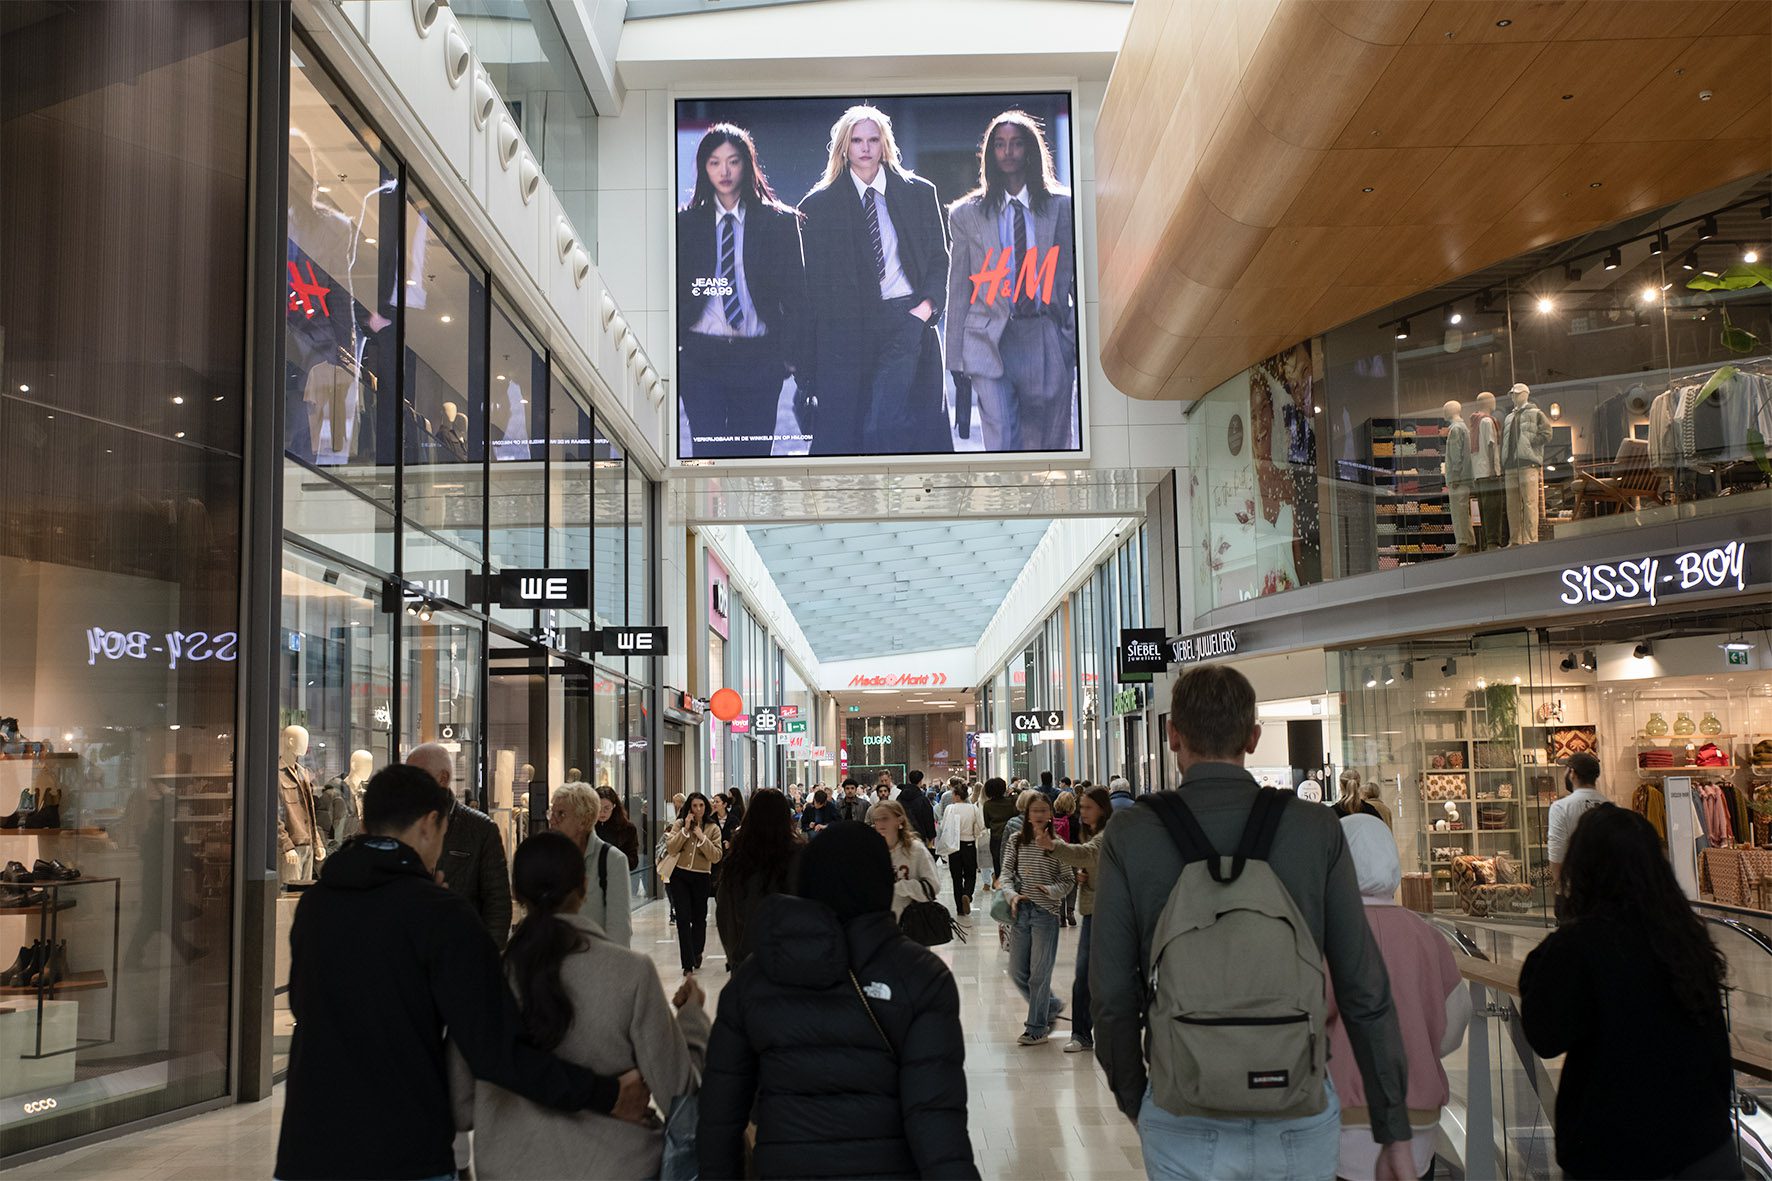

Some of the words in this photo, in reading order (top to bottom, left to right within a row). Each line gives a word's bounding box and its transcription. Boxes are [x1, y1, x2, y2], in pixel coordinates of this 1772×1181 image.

[691, 277, 729, 288] JEANS
[968, 245, 1061, 308] H&M
[691, 287, 701, 297] €
[520, 577, 568, 600] WE
[617, 632, 653, 650] WE
[1172, 639, 1196, 663] SIEBEL
[1196, 629, 1238, 661] JUWELIERS
[1127, 644, 1161, 657] SIEBEL
[1014, 714, 1042, 730] C&A
[863, 735, 892, 745] DOUGLAS
[23, 1097, 58, 1114] ecco
